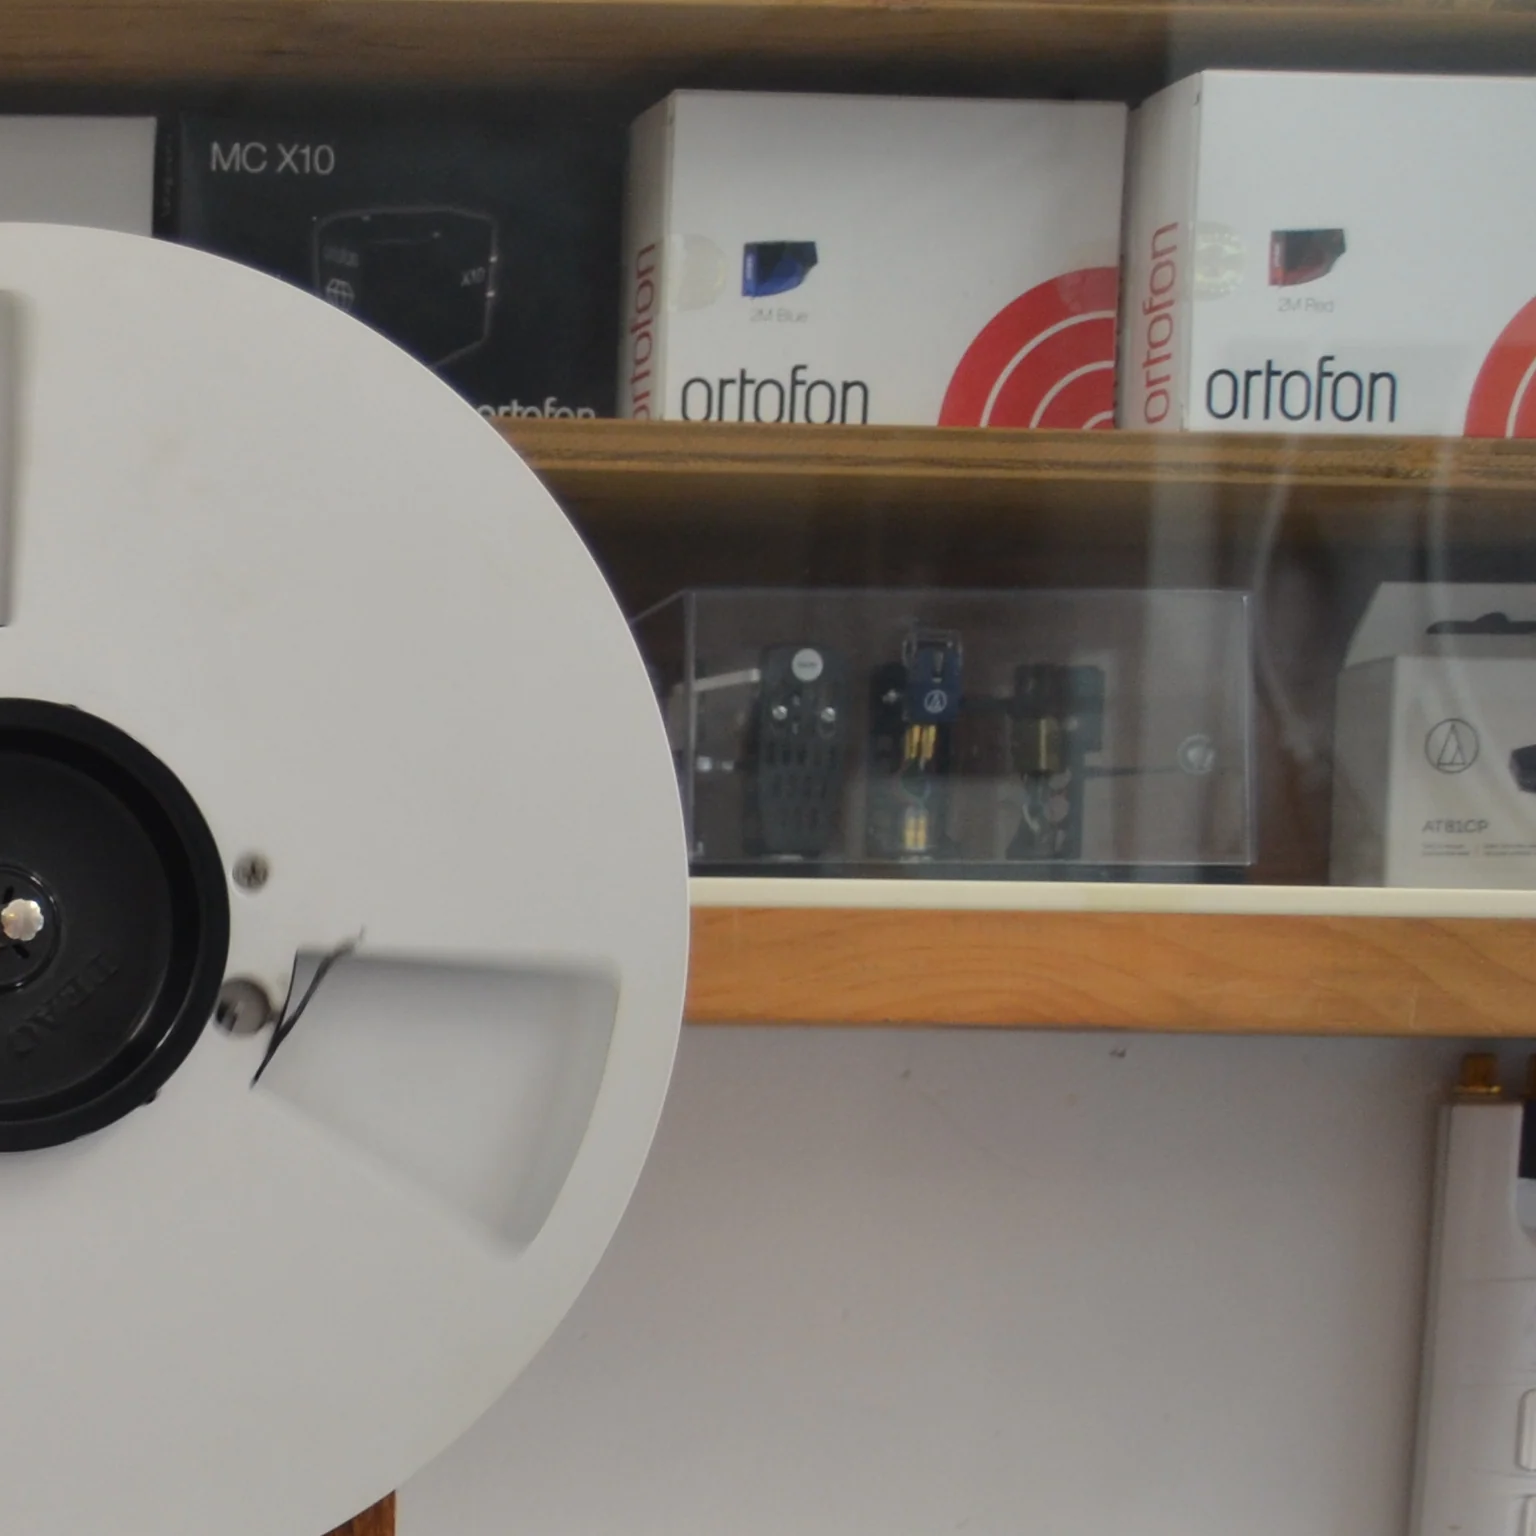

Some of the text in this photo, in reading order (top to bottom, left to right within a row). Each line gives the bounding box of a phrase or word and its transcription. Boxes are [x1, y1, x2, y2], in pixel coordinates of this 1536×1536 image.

[210, 142, 336, 174] MC X10
[1142, 221, 1179, 425] ortofon
[680, 365, 869, 425] ortofon
[1206, 355, 1397, 422] ortofon
